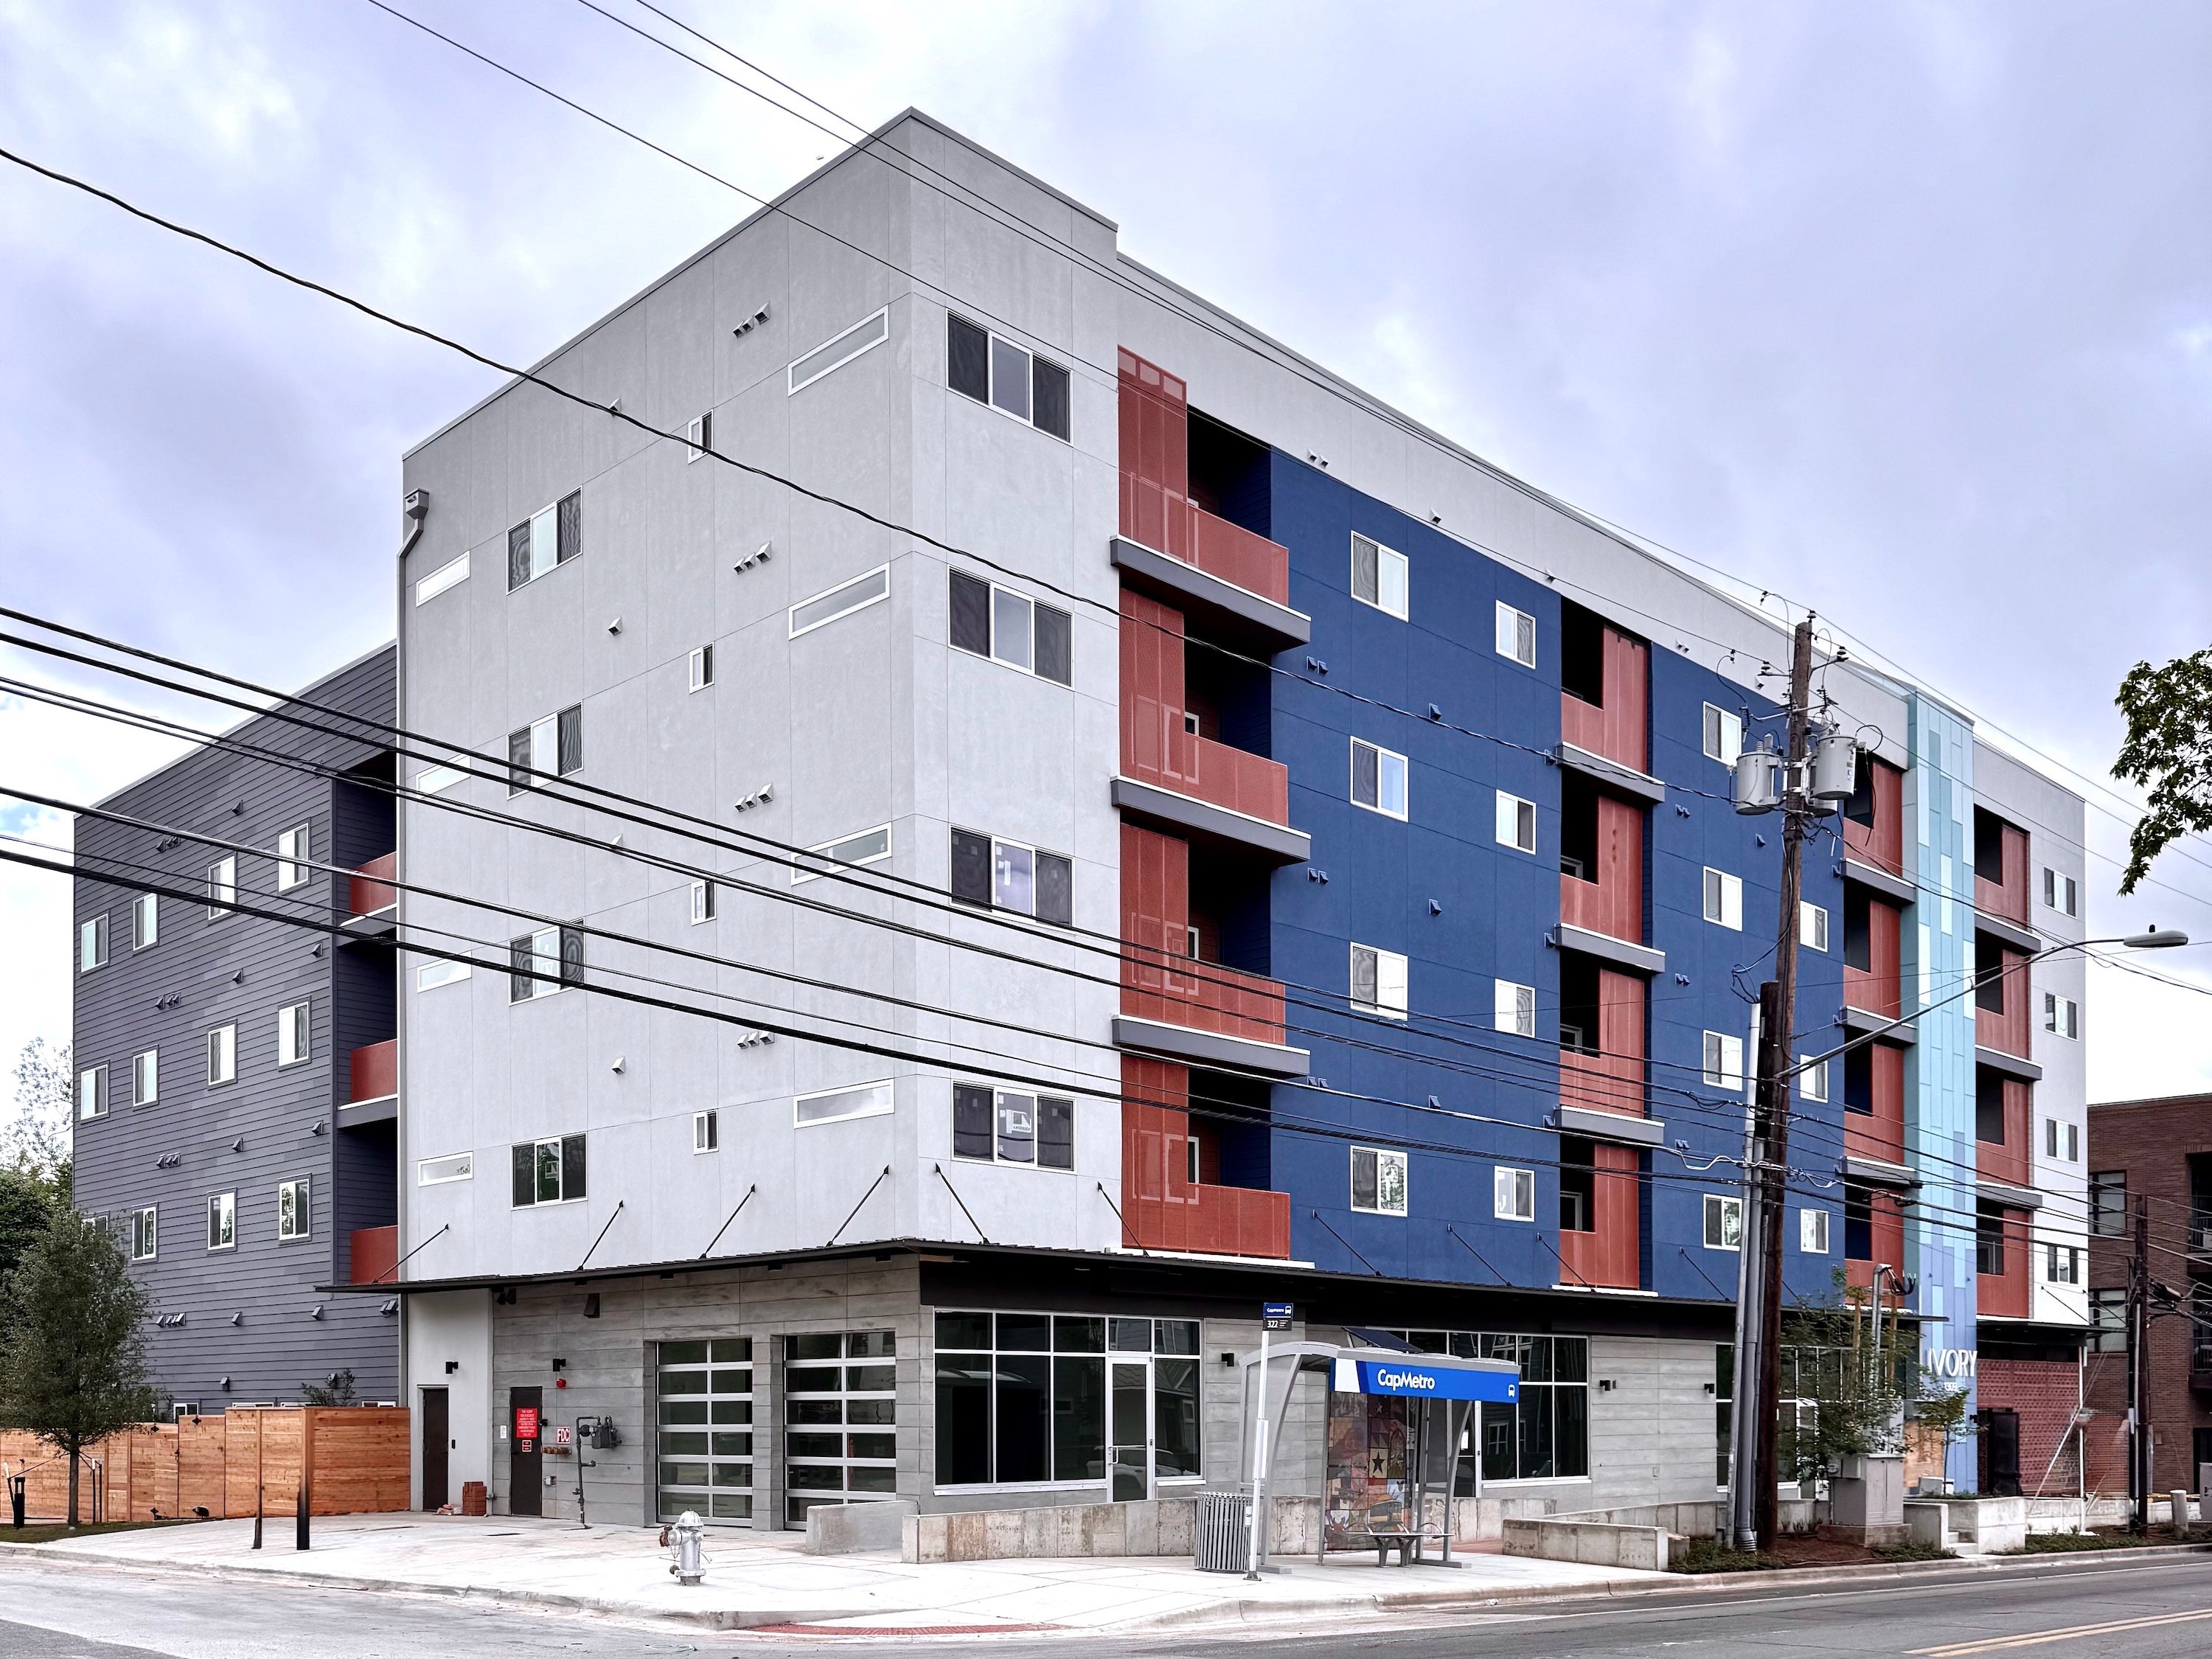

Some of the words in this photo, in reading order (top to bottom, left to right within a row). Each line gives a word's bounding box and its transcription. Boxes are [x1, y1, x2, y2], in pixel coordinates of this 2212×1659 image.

[1267, 1320, 1279, 1328] 322
[1928, 1348, 1978, 1377] IVORY
[1377, 1368, 1436, 1391] CapMetro
[557, 1428, 570, 1442] FDC
